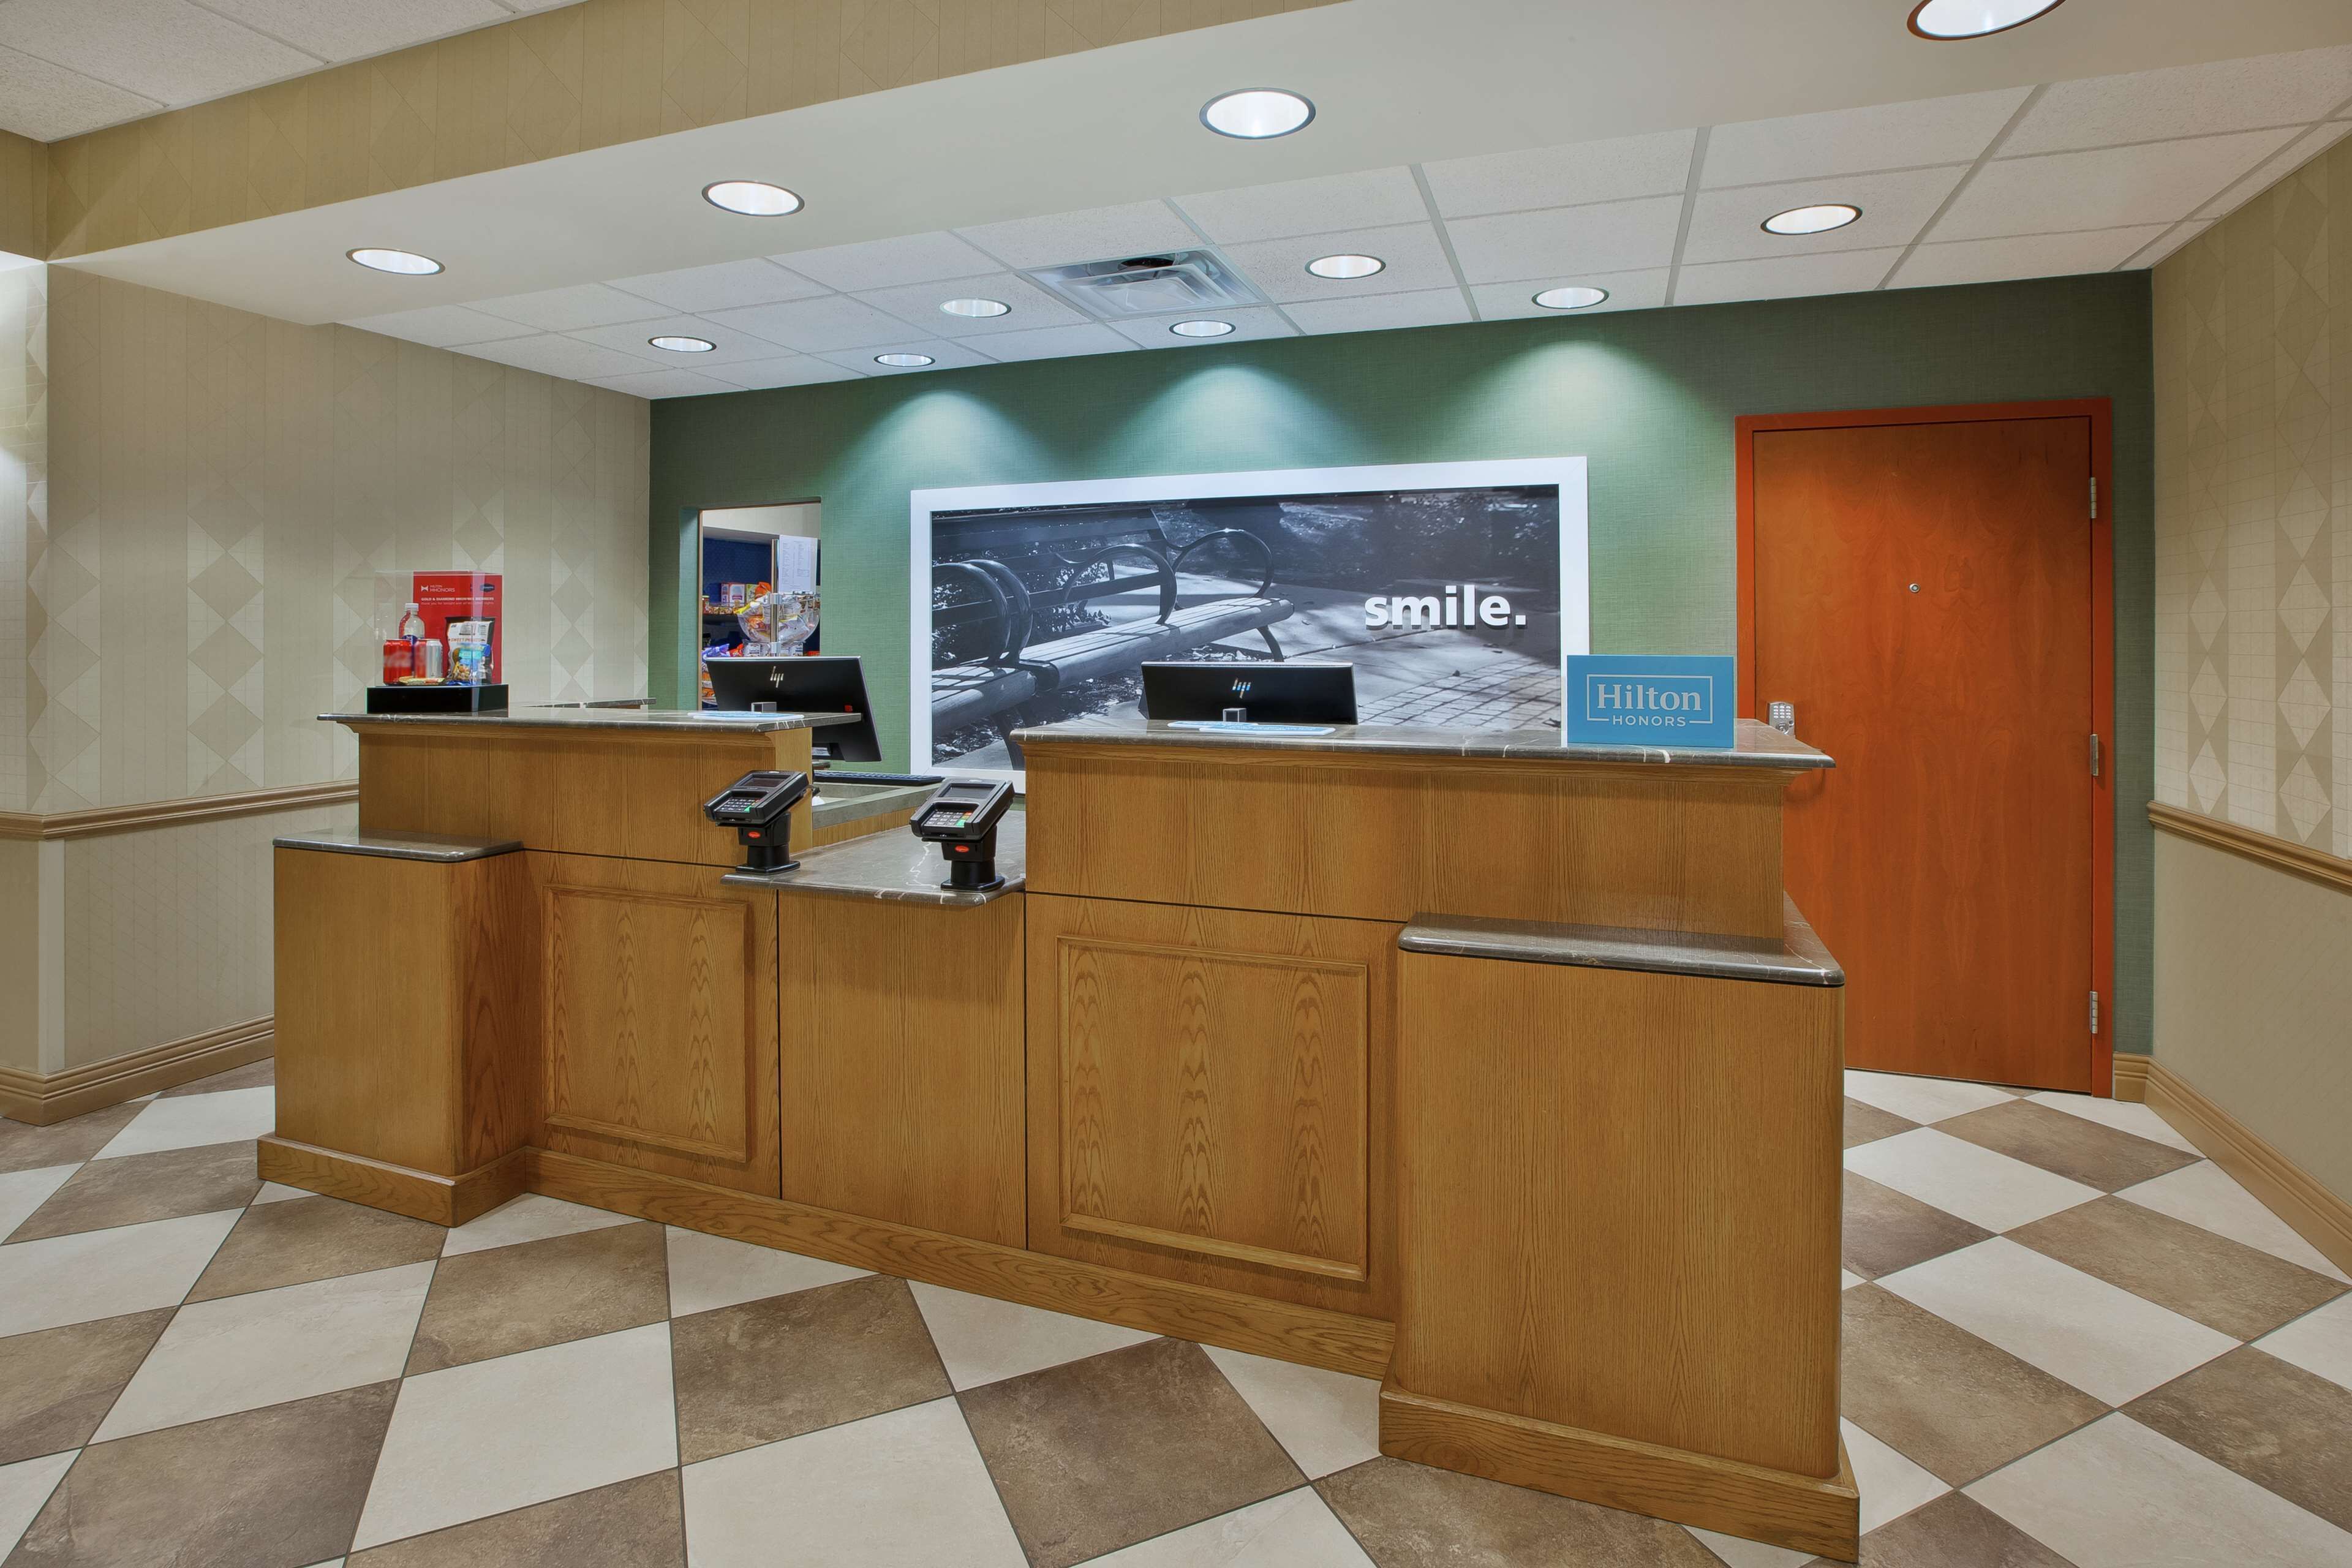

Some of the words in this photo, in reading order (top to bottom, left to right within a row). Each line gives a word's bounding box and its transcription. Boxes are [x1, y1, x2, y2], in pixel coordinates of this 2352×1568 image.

[1365, 584, 1526, 626] smile.
[1597, 684, 1702, 711] Hilton
[1612, 715, 1686, 727] HONORS
